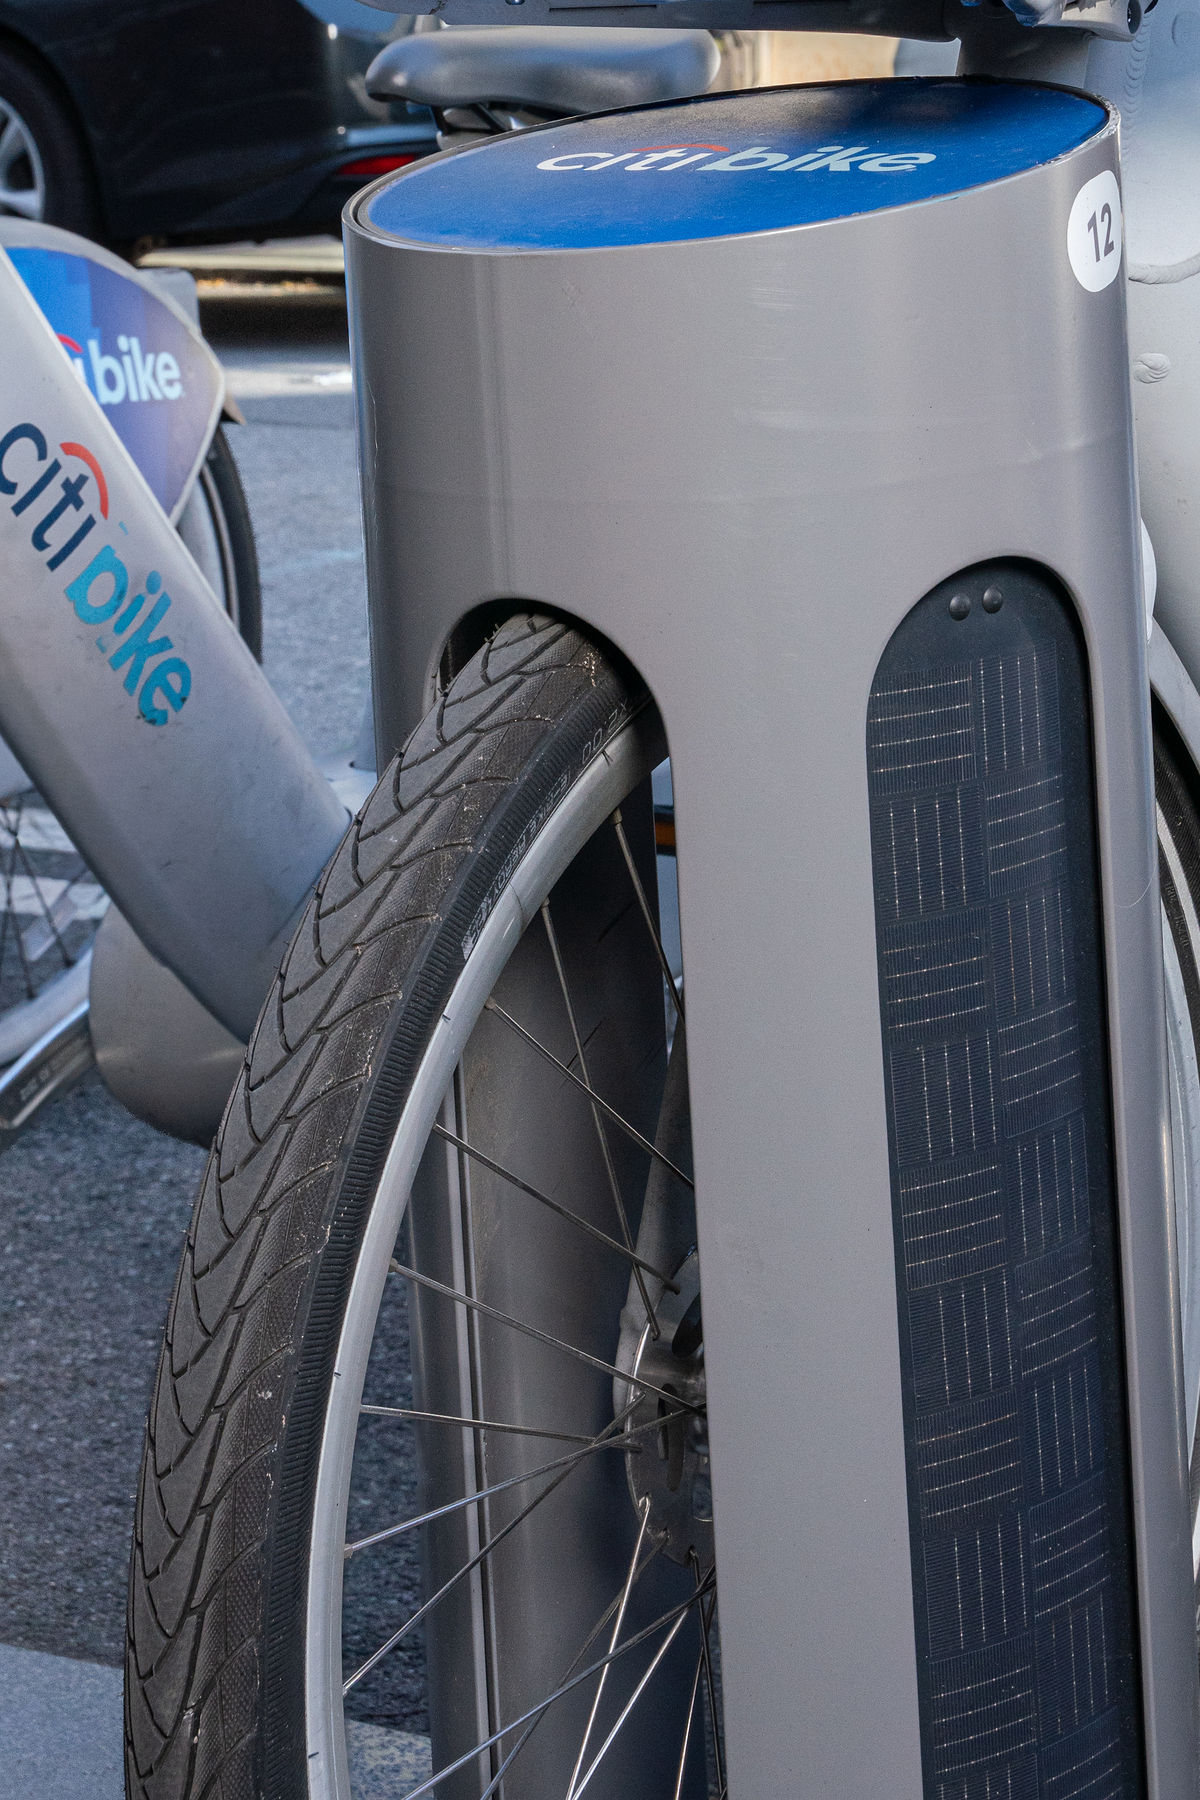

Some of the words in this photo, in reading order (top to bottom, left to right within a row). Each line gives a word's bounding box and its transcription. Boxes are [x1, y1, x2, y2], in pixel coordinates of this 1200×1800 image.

[536, 143, 722, 173] citi
[704, 144, 936, 173] bike
[1087, 202, 1116, 264] 12
[87, 334, 183, 405] bike
[0, 422, 109, 571] citi
[64, 521, 193, 727] bike
